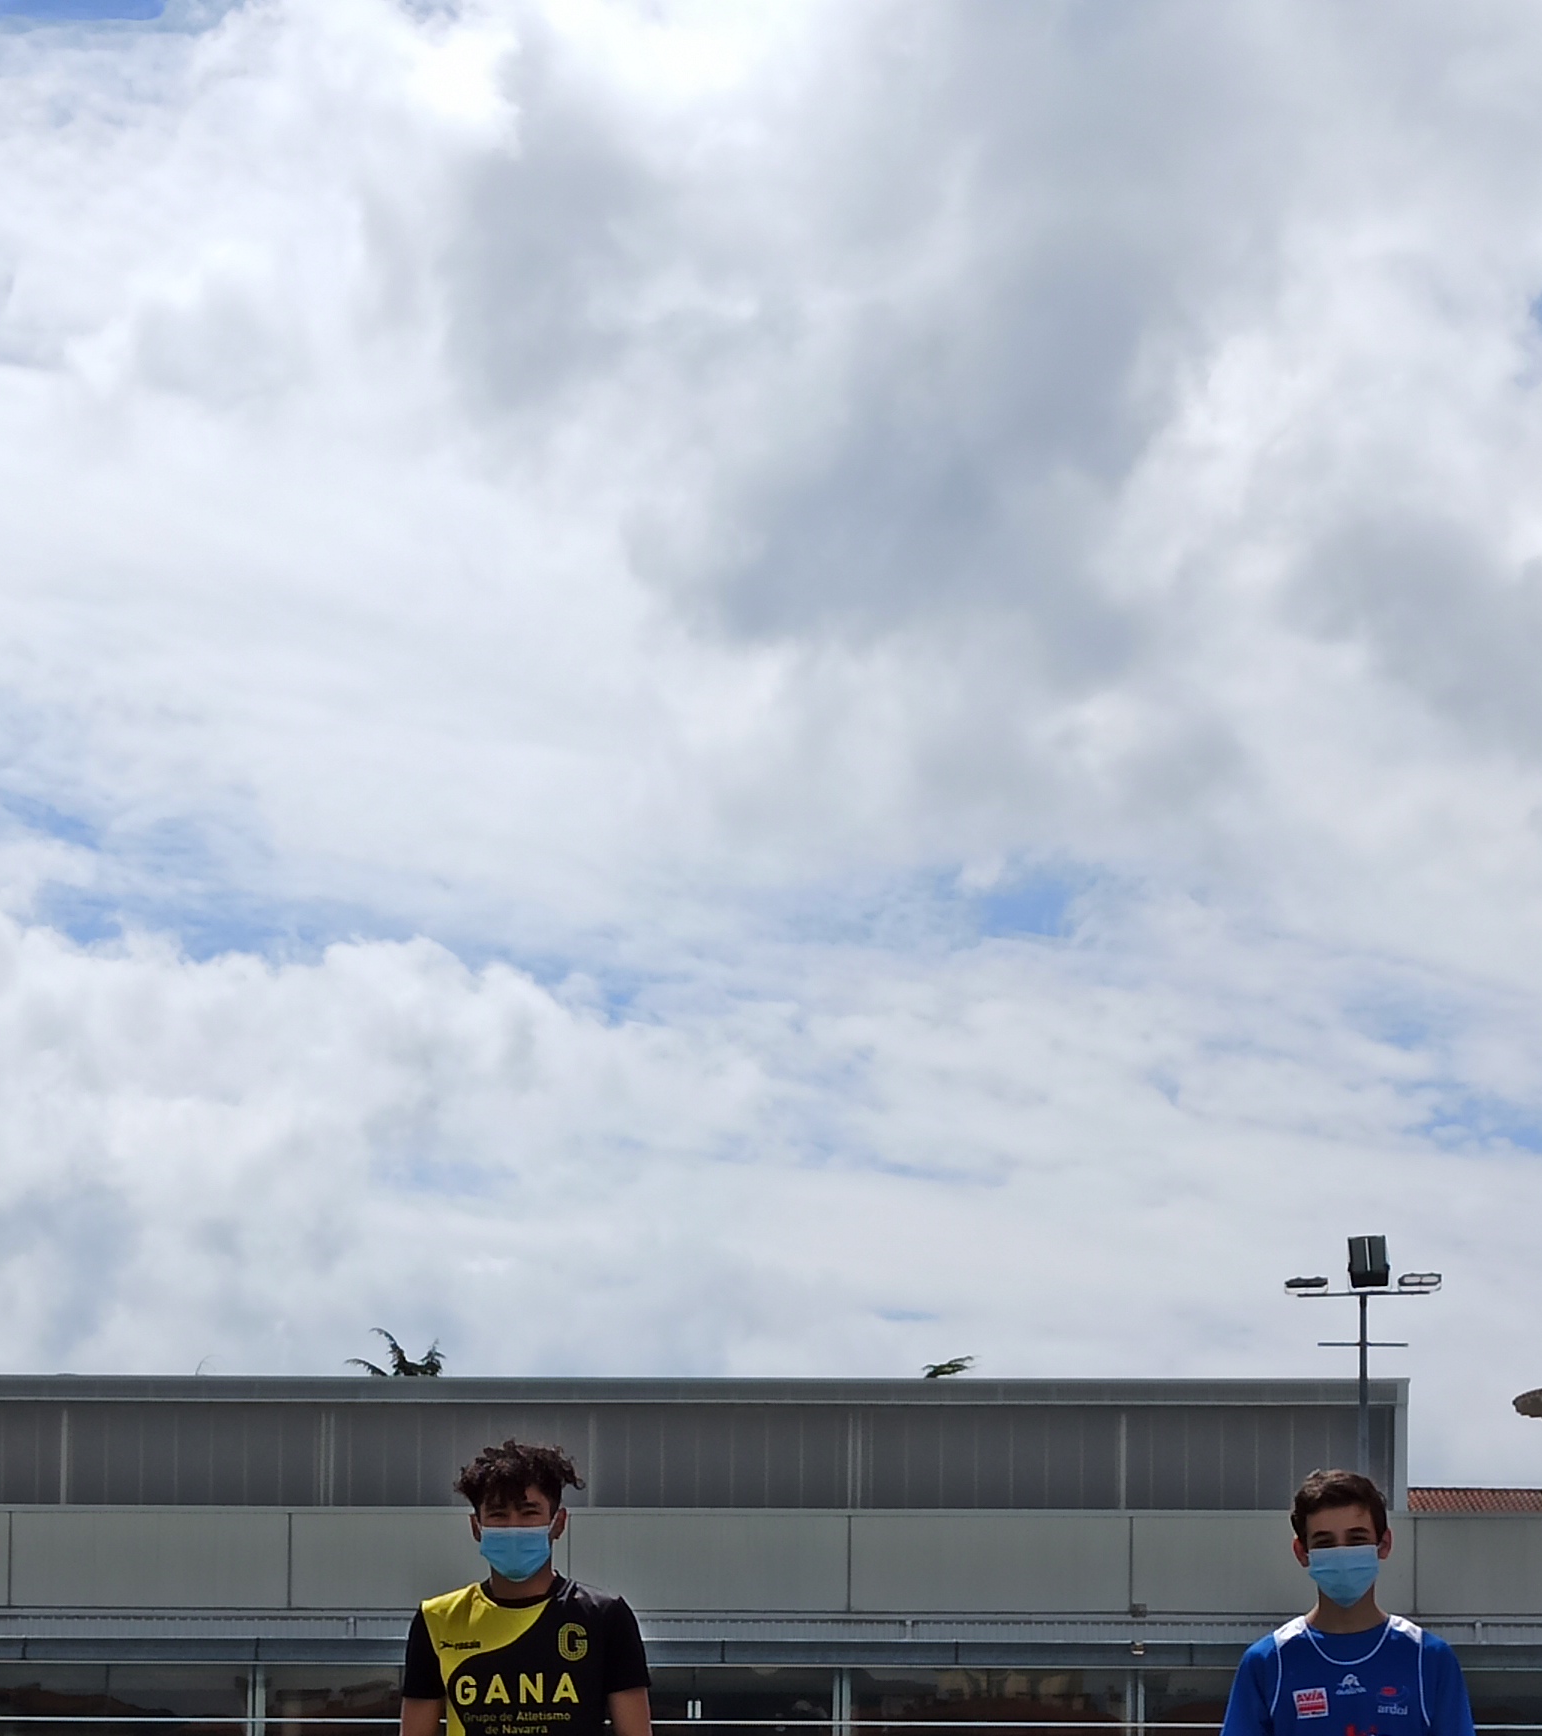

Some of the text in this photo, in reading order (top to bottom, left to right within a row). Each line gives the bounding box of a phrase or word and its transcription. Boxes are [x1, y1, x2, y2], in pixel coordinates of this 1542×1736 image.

[455, 1672, 579, 1706] GANA
[516, 1710, 571, 1722] Atletismo
[502, 1724, 548, 1735] Navarra
